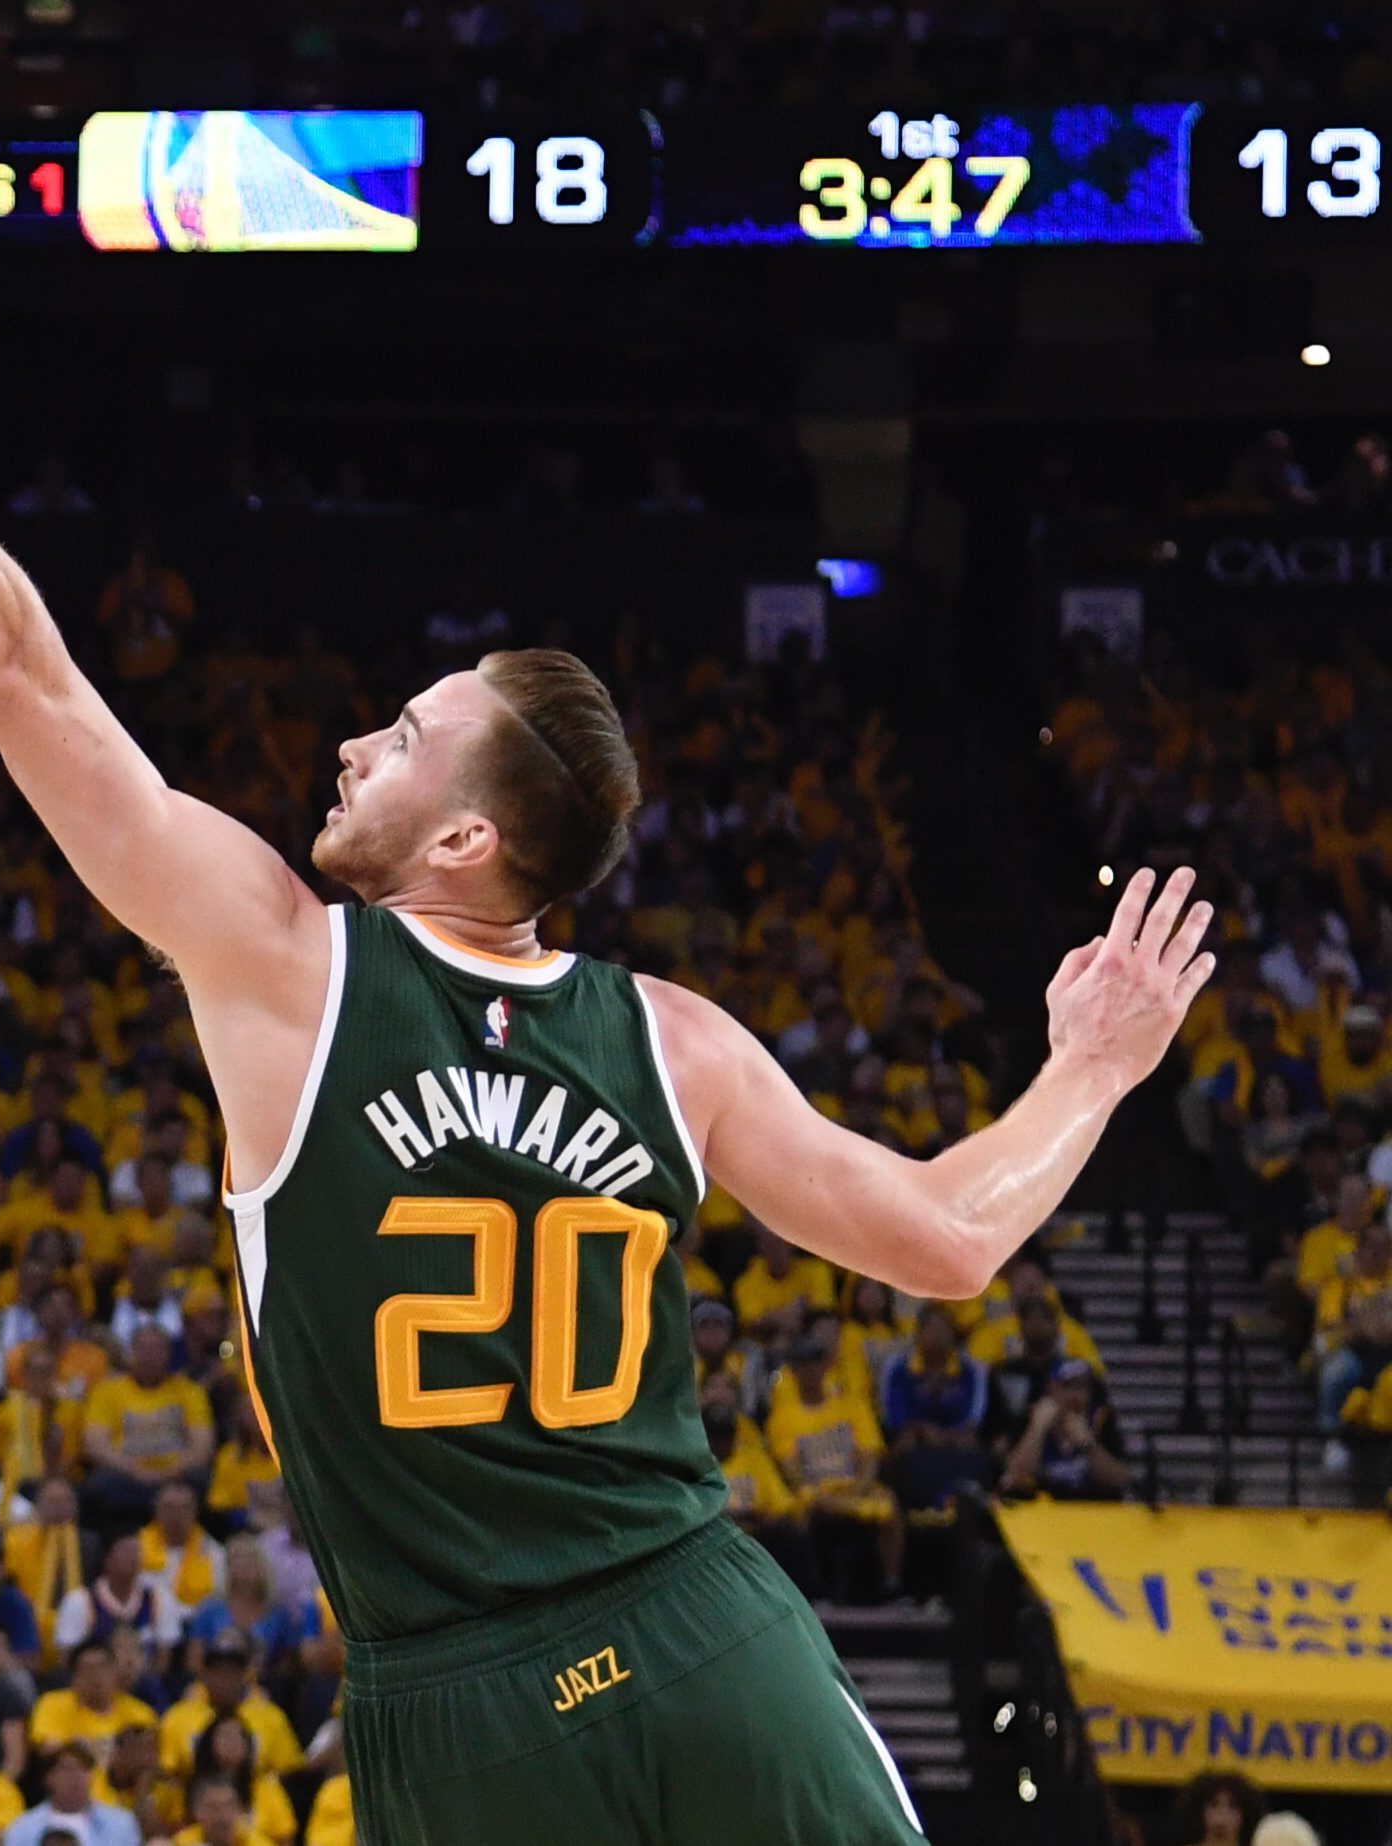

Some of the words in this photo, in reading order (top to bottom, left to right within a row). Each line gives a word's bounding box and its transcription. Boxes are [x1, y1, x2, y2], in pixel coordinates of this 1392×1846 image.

[868, 110, 960, 160] 1st
[1238, 127, 1381, 218] 13
[29, 162, 64, 216] 1
[466, 136, 607, 225] 18
[799, 156, 1031, 240] 3:47
[364, 1066, 655, 1199] HAYWARD
[374, 1195, 668, 1430] 20
[553, 1645, 632, 1712] JAZZ
